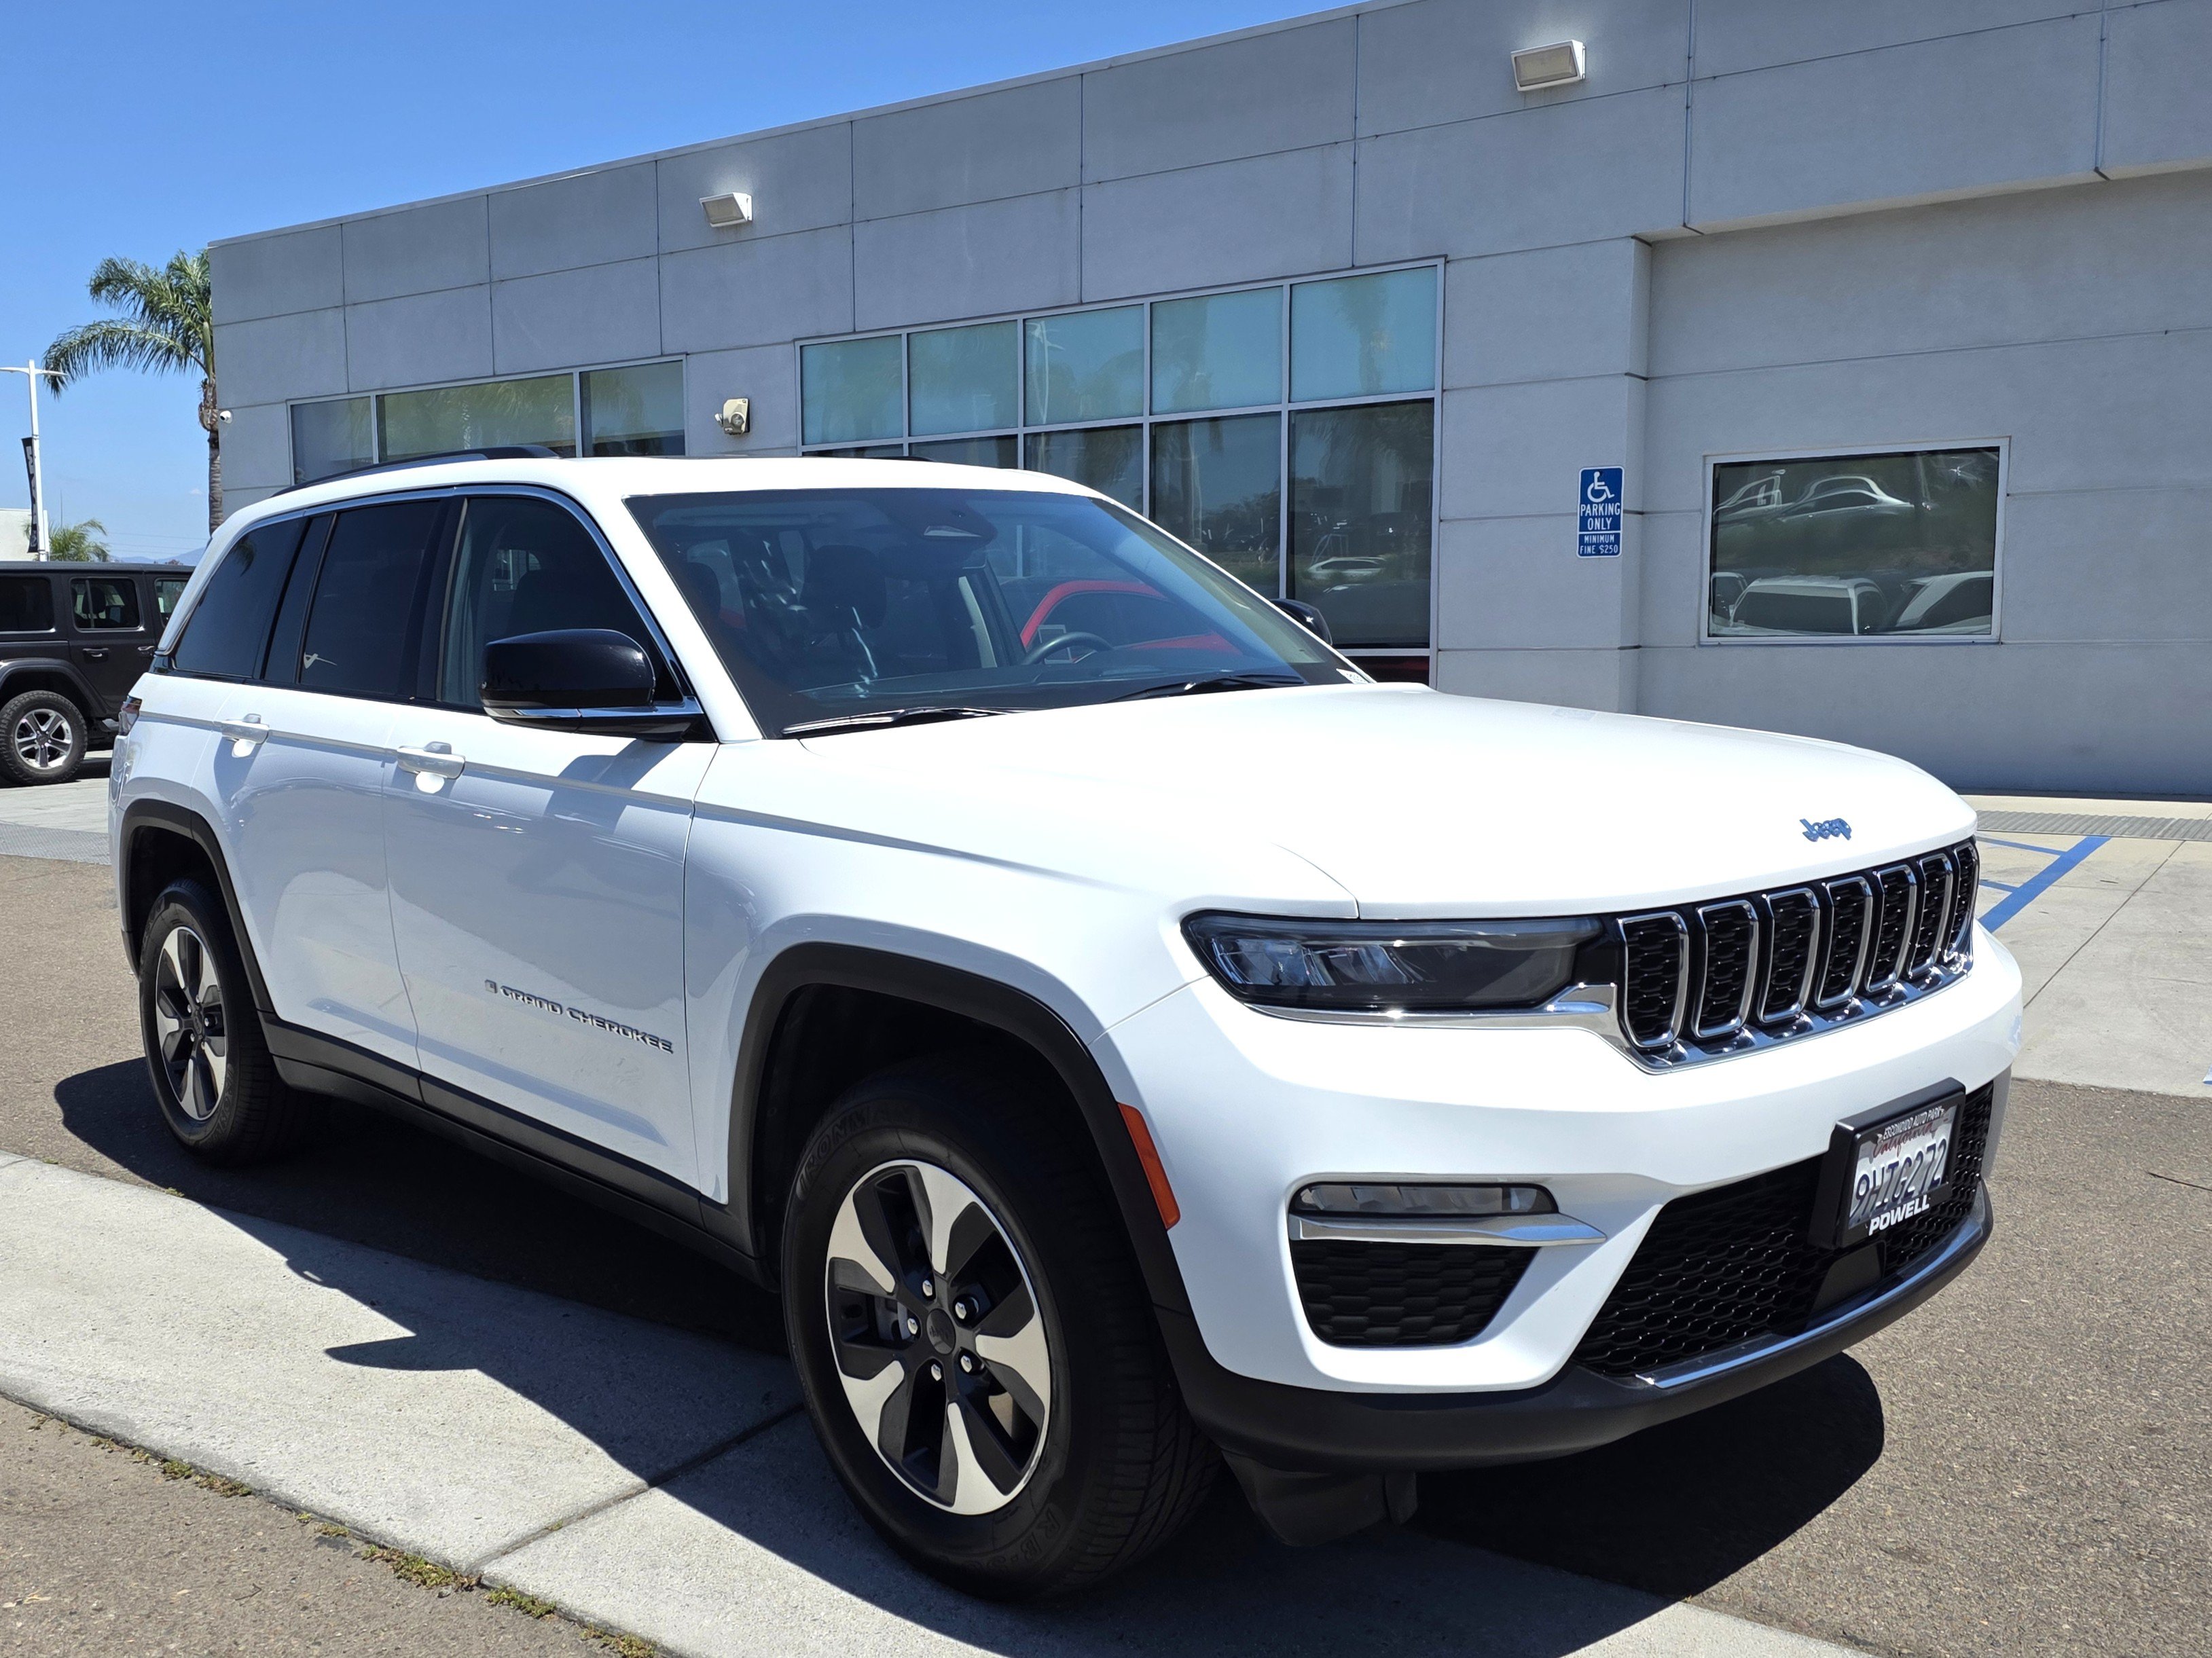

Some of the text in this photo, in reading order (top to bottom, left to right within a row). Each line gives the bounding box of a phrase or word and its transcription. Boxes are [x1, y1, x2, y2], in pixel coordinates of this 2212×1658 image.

[1580, 502, 1620, 517] PARKING
[1587, 517, 1612, 530] ONLY
[1580, 545, 1618, 555] FINE $250
[1584, 534, 1615, 544] MINIMUM
[1799, 817, 1852, 843] Jeep
[500, 985, 674, 1054] GRAND CHEROKEE
[1912, 1111, 1928, 1128] AUTO
[1927, 1105, 1943, 1122] PARK
[1873, 1122, 1936, 1158] California
[1869, 1194, 1930, 1236] POWELL
